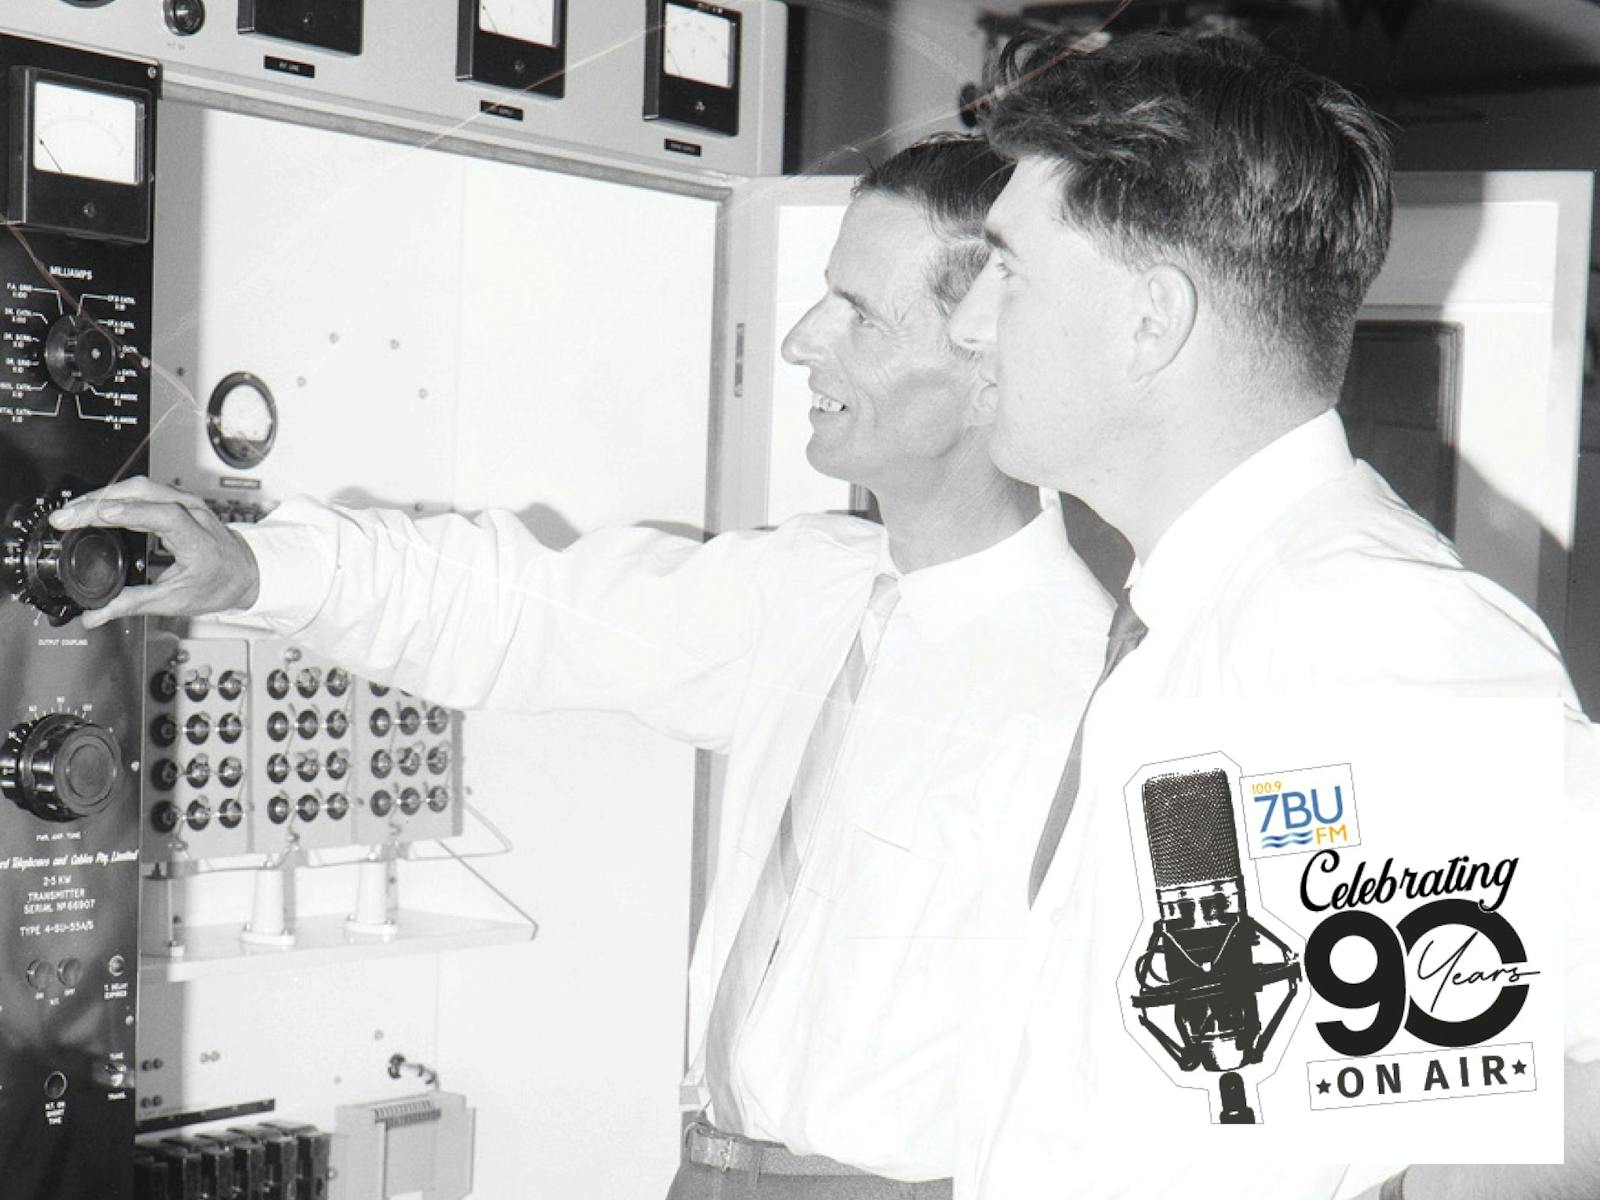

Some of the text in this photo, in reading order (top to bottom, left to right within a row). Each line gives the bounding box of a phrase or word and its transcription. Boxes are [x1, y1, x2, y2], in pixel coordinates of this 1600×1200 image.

[53, 854, 69, 866] and
[27, 888, 85, 903] TRANSMITTER
[24, 903, 54, 915] SERIAL
[19, 925, 41, 937] TYPE
